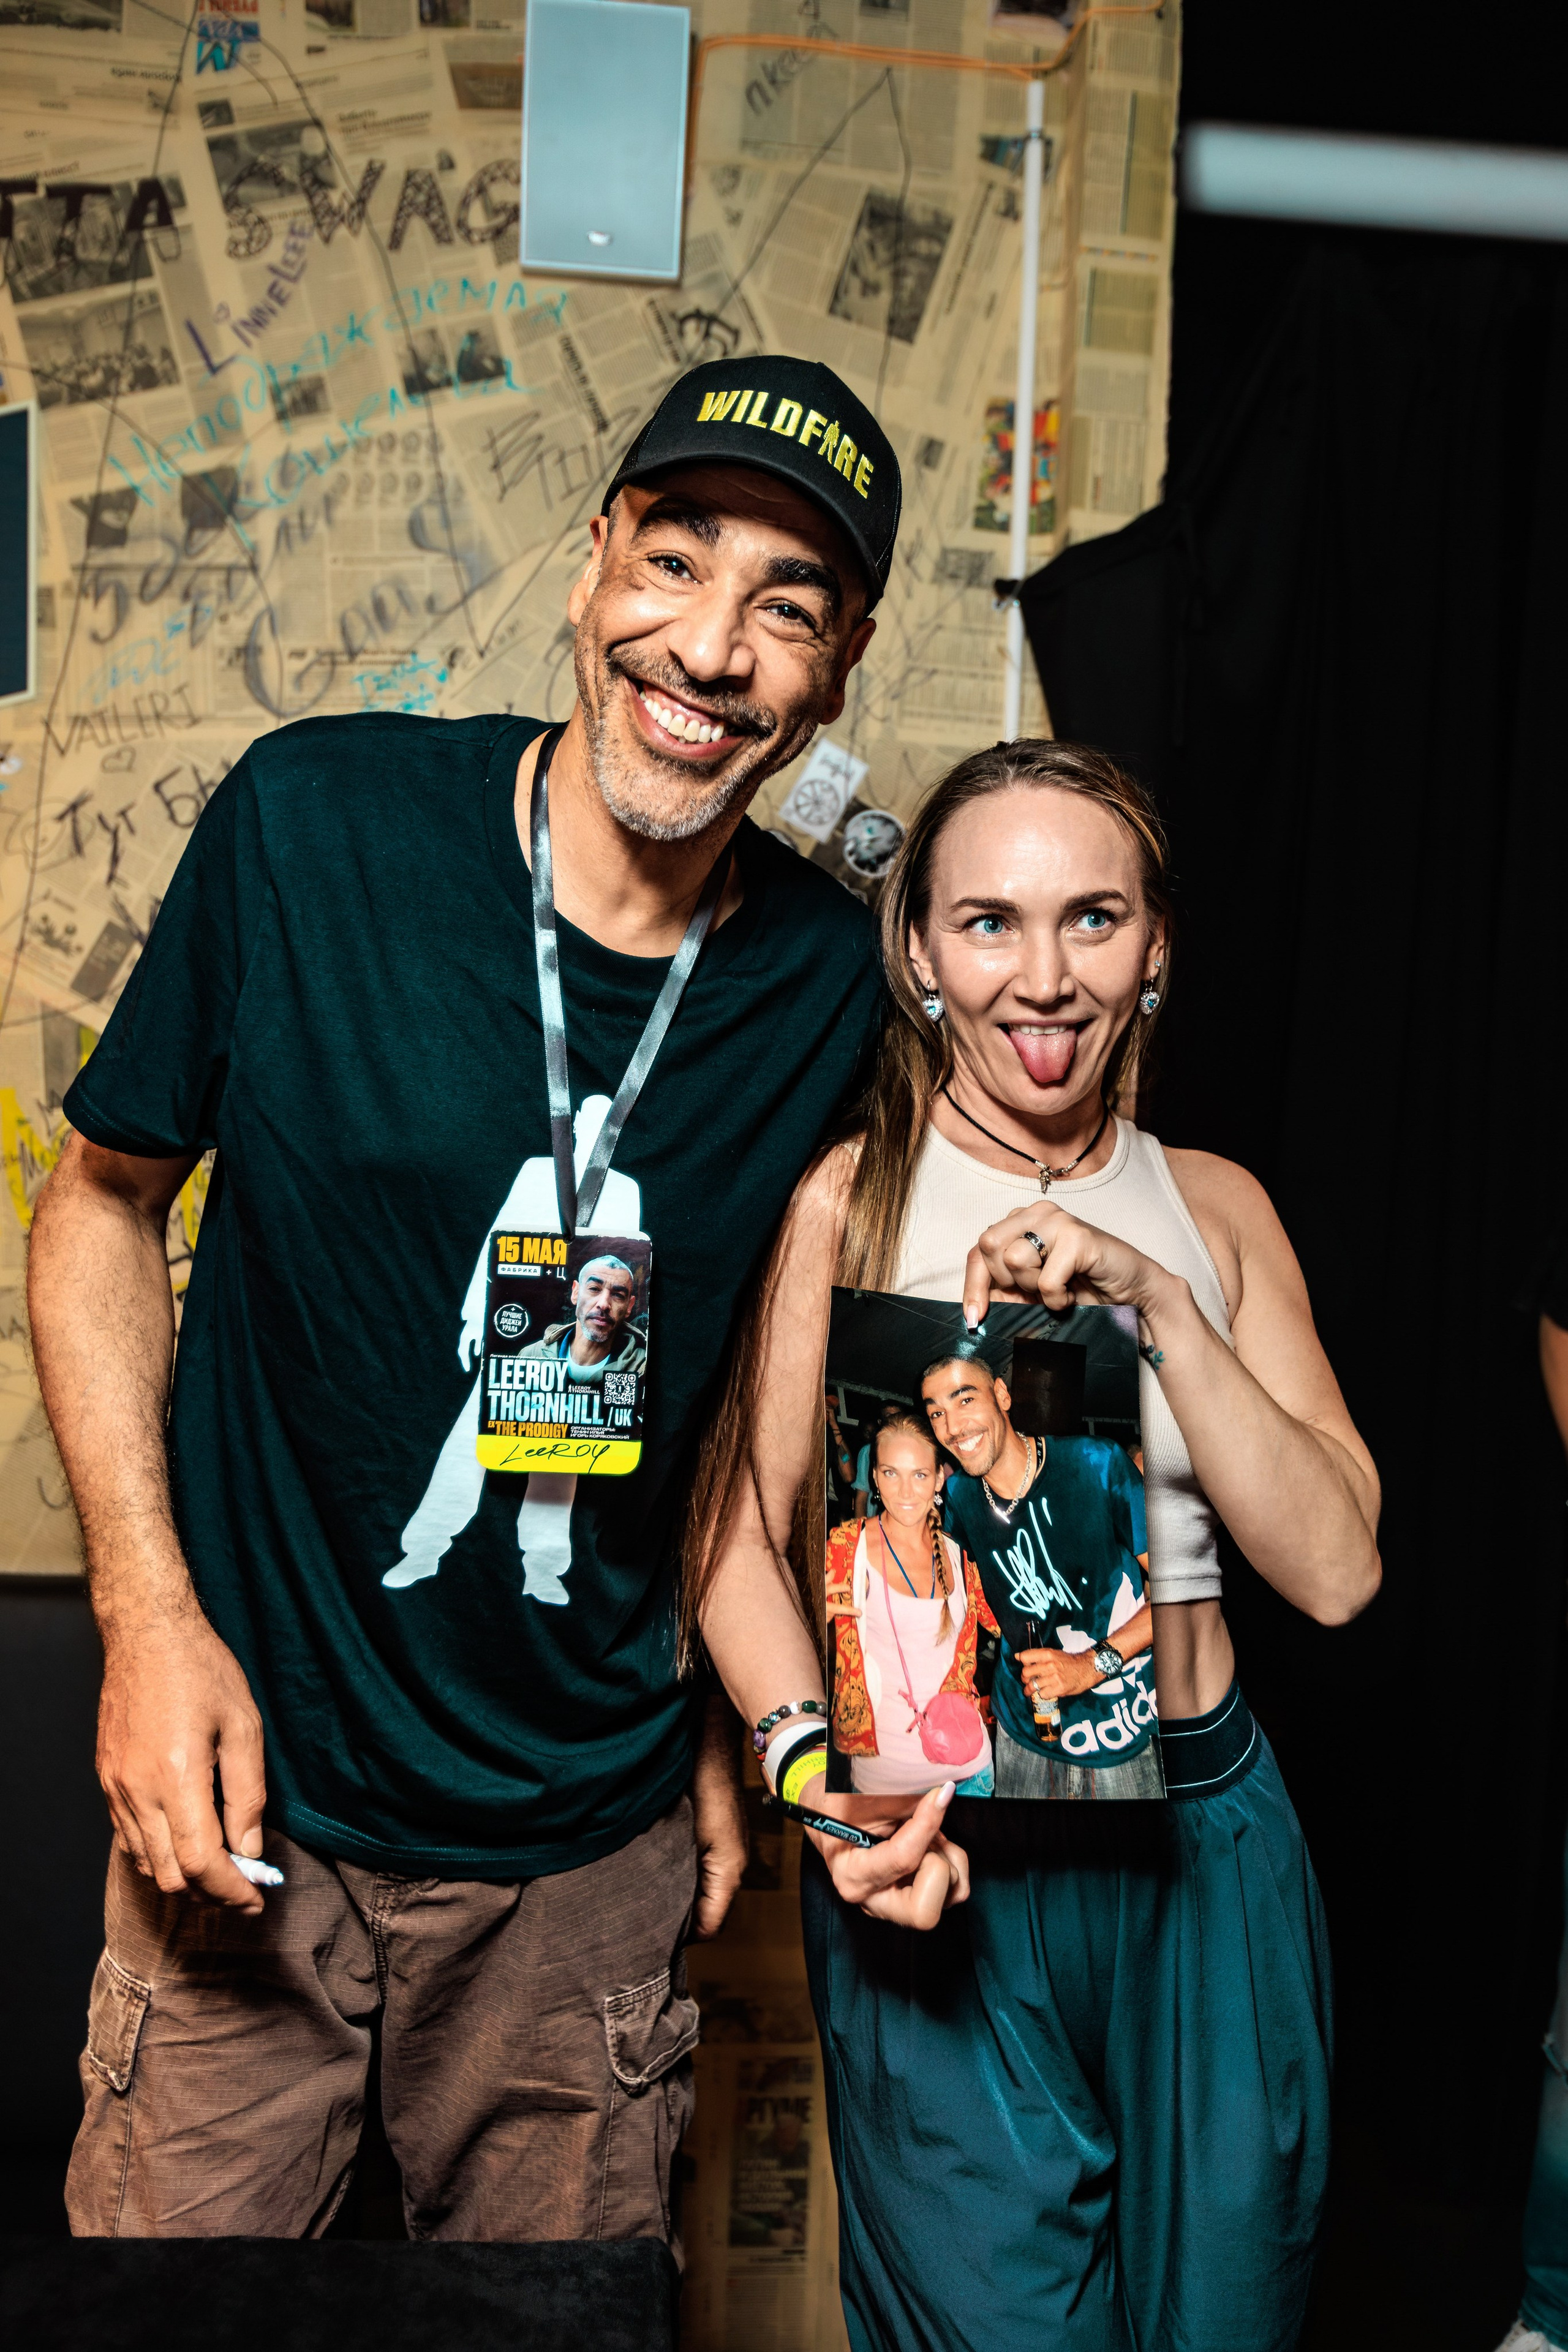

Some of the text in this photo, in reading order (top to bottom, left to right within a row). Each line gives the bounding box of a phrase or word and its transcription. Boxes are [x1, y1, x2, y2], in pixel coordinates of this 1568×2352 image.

[497, 1236, 567, 1265] 15 МАЯ
[502, 1311, 522, 1319] ЛУЧШИЕ
[488, 1359, 569, 1392] LEEROY
[487, 1390, 604, 1425] THORNHILL
[495, 1421, 517, 1436] THE
[518, 1422, 568, 1438] PRODIGY
